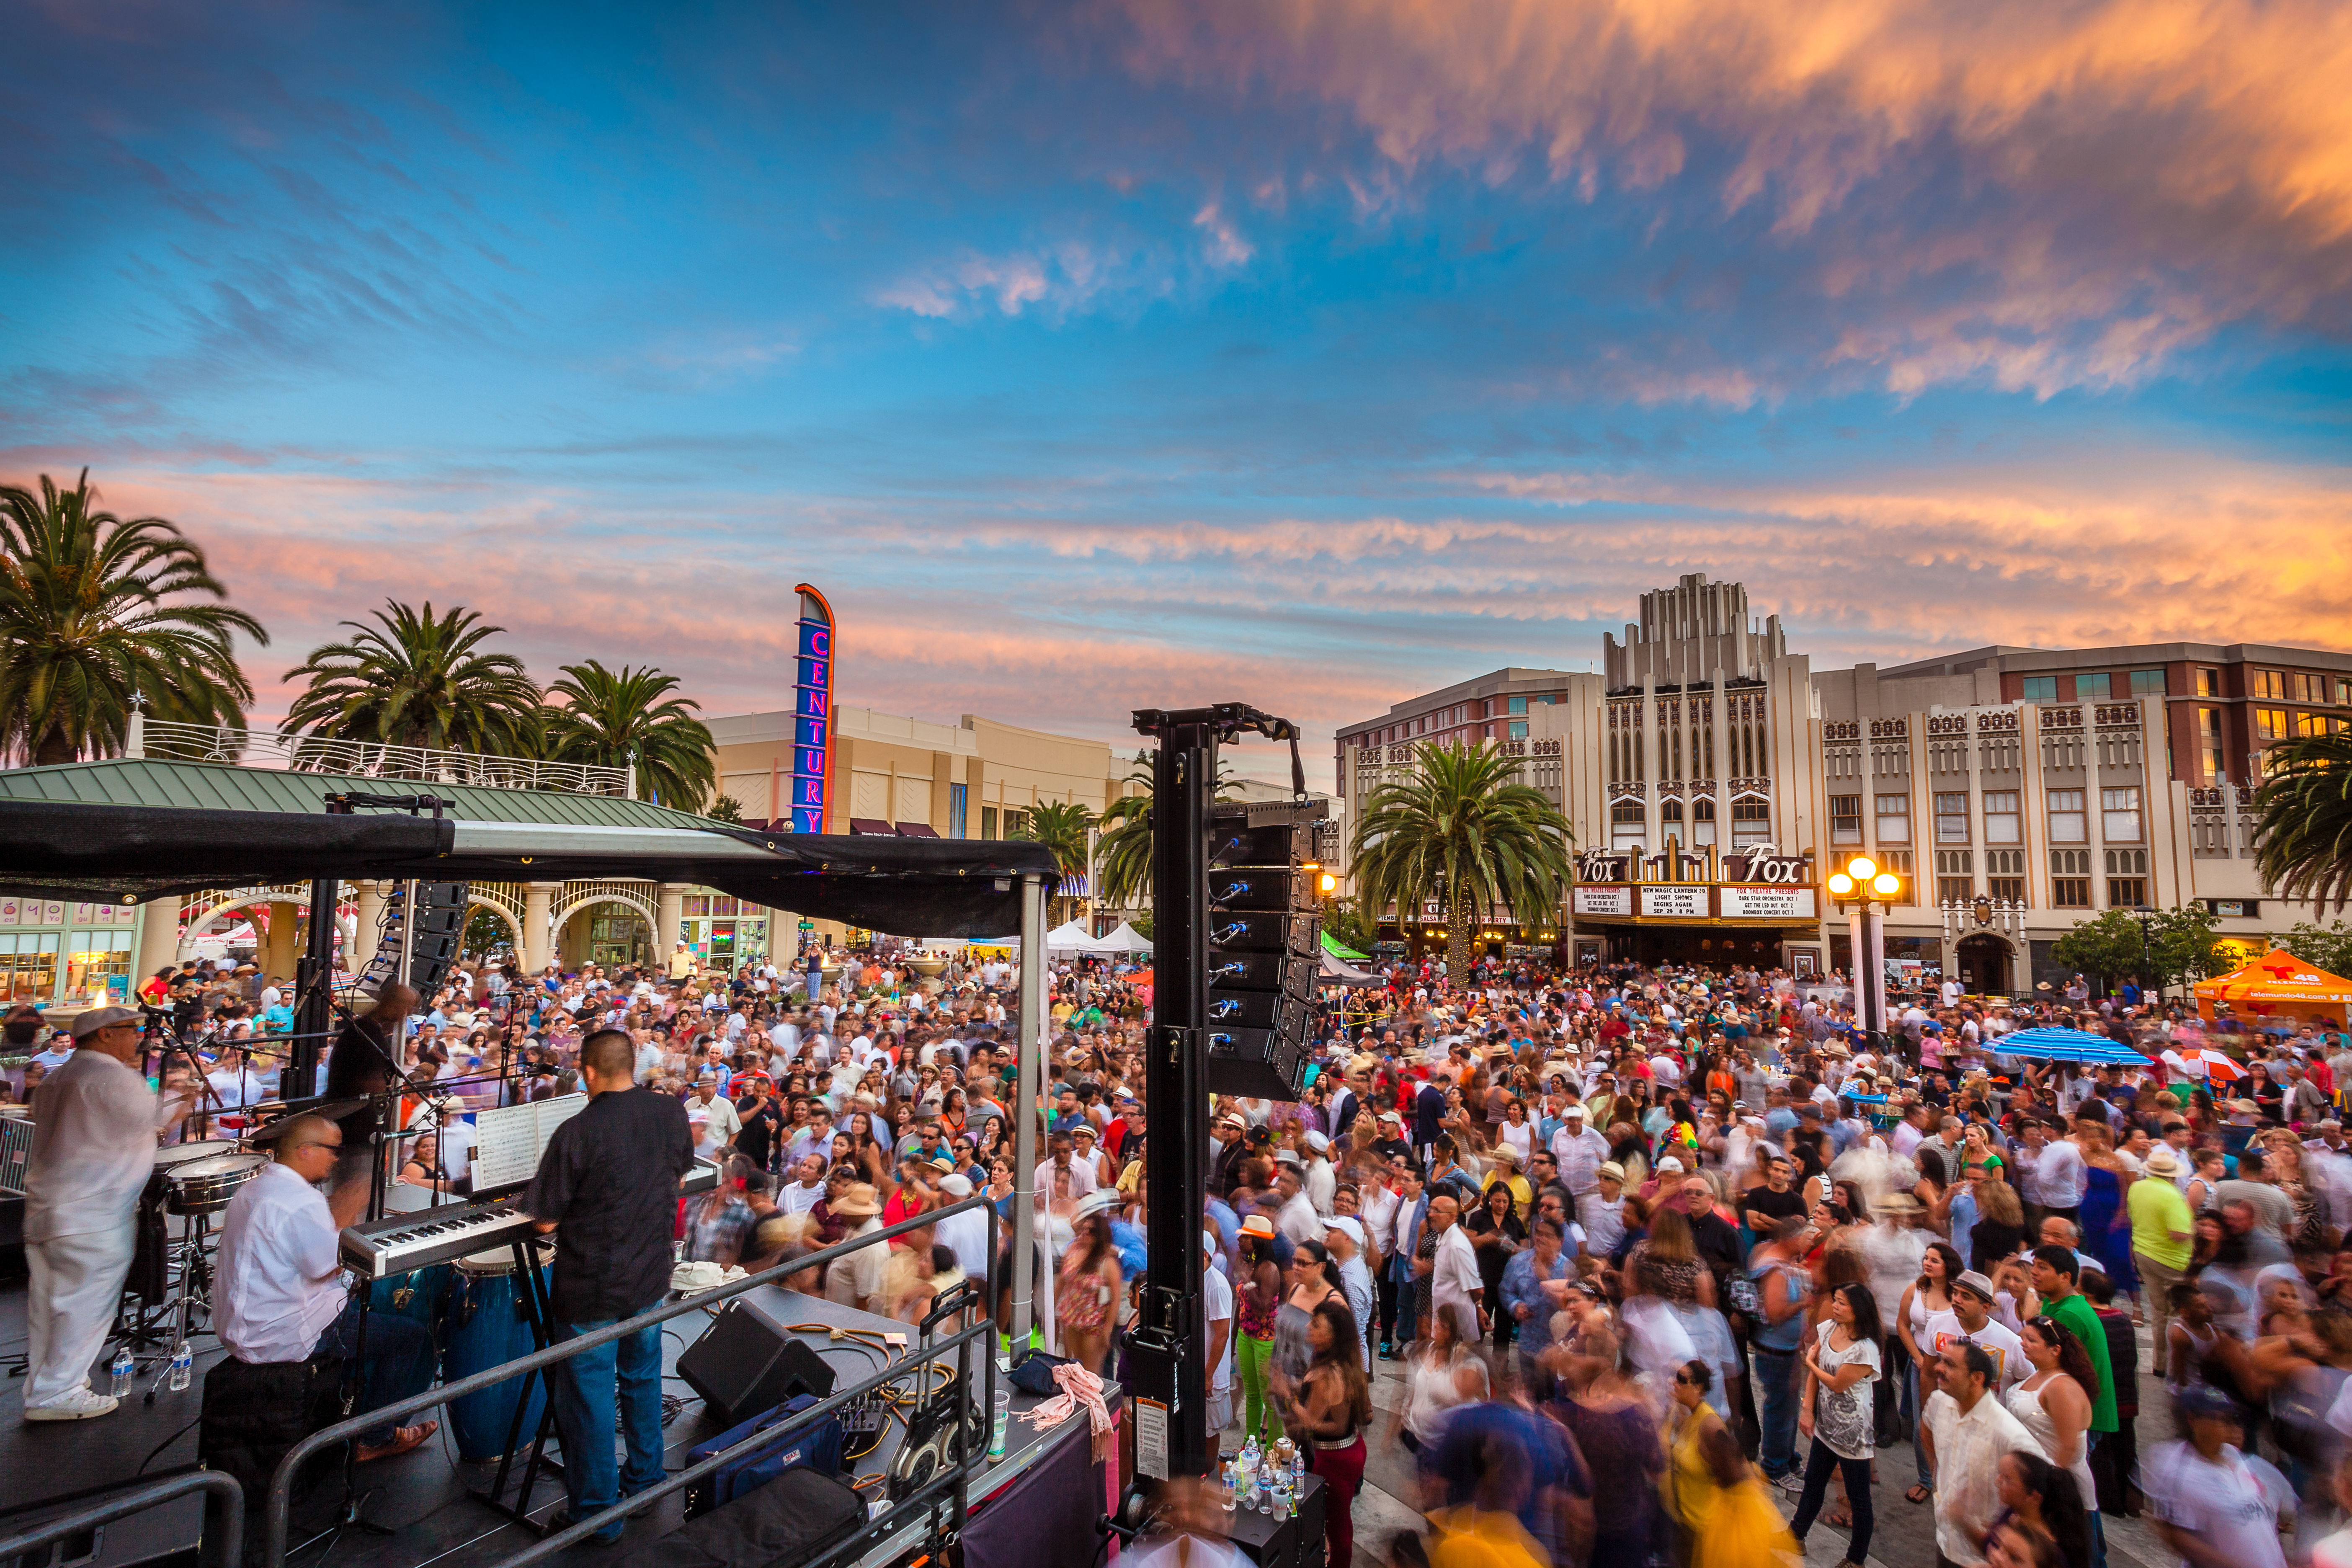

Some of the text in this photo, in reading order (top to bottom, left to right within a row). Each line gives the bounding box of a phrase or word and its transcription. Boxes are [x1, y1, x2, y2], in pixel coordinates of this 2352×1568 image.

[804, 632, 828, 833] CENTURY
[1741, 842, 1800, 883] Fox
[691, 902, 756, 911] Chatime
[2250, 991, 2327, 1000] telemundo48.com
[786, 1451, 797, 1461] MAX
